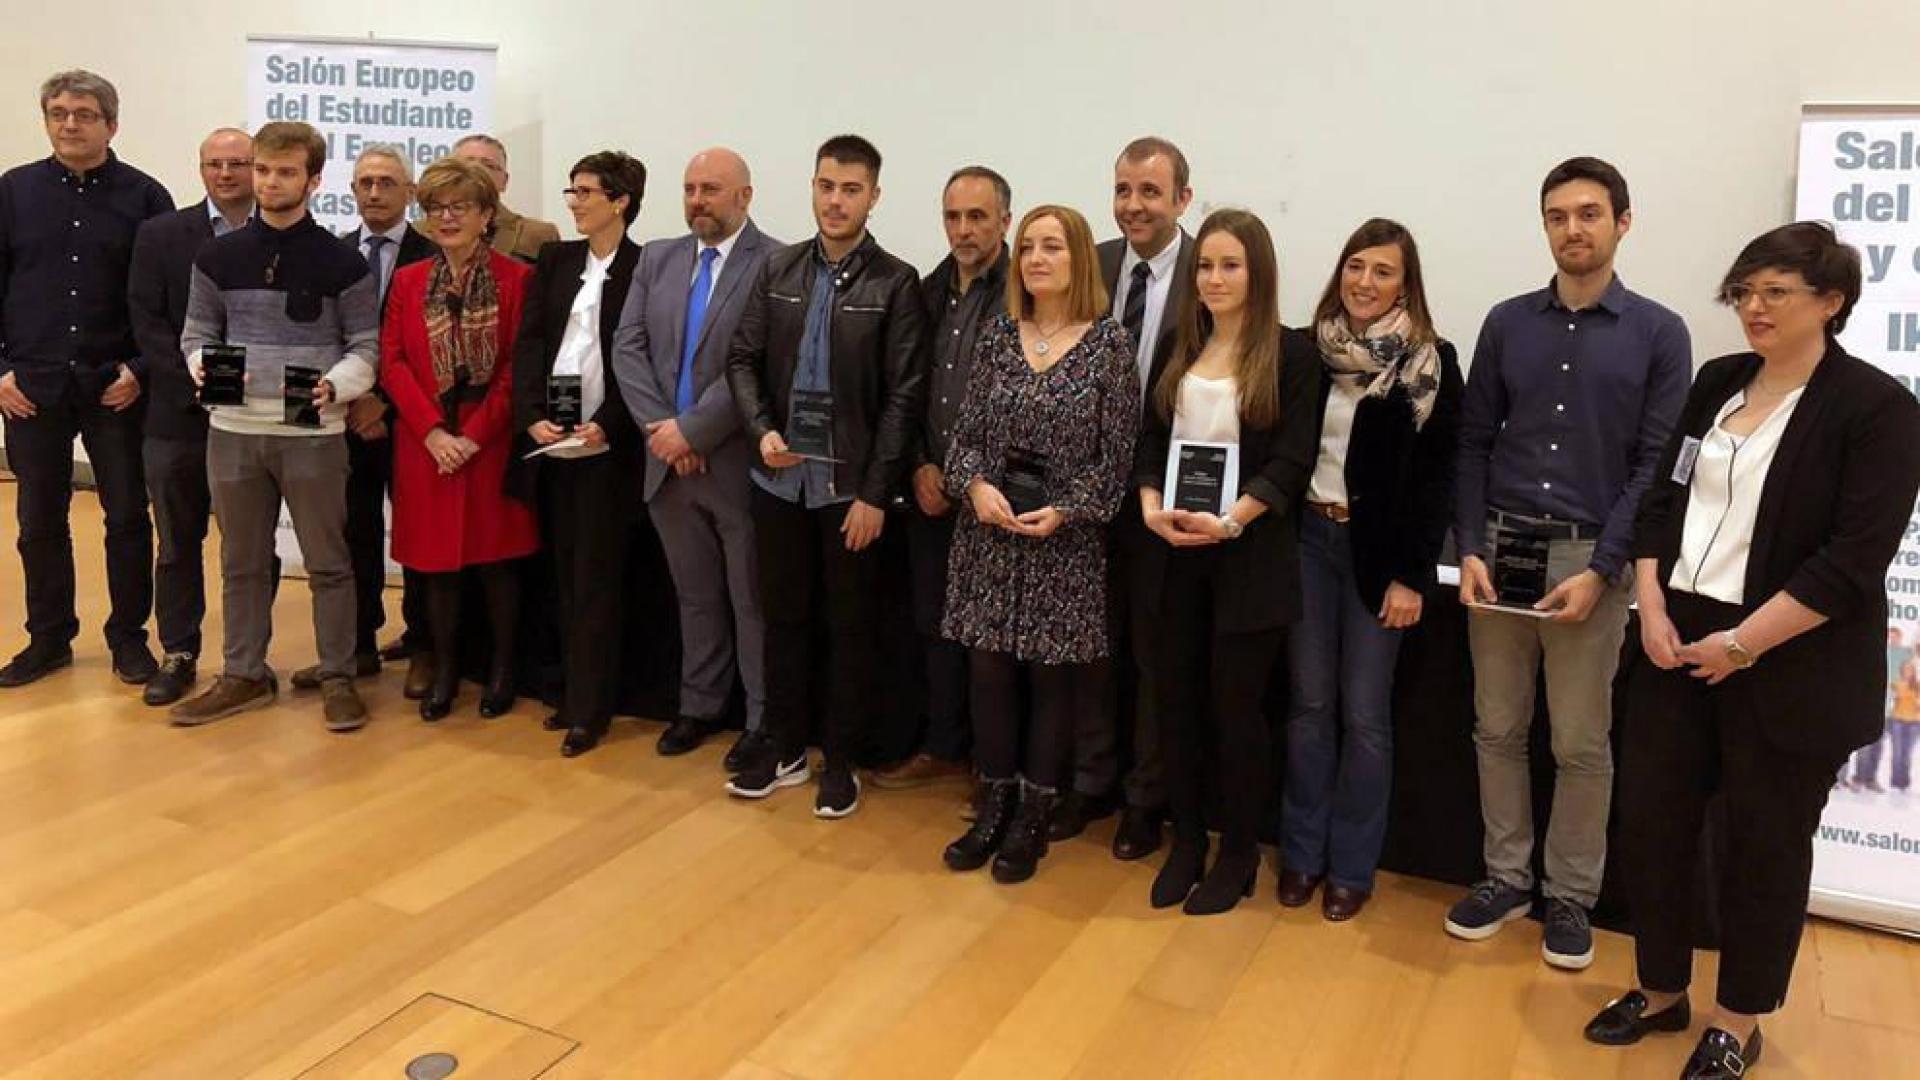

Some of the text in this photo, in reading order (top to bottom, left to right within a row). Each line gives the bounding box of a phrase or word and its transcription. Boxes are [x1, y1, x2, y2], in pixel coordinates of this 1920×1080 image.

[265, 54, 475, 96] Salón Europeo
[266, 93, 473, 130] del Estudiante
[346, 133, 450, 165] Eleo
[1834, 131, 1920, 171] Sal
[1833, 183, 1910, 222] del
